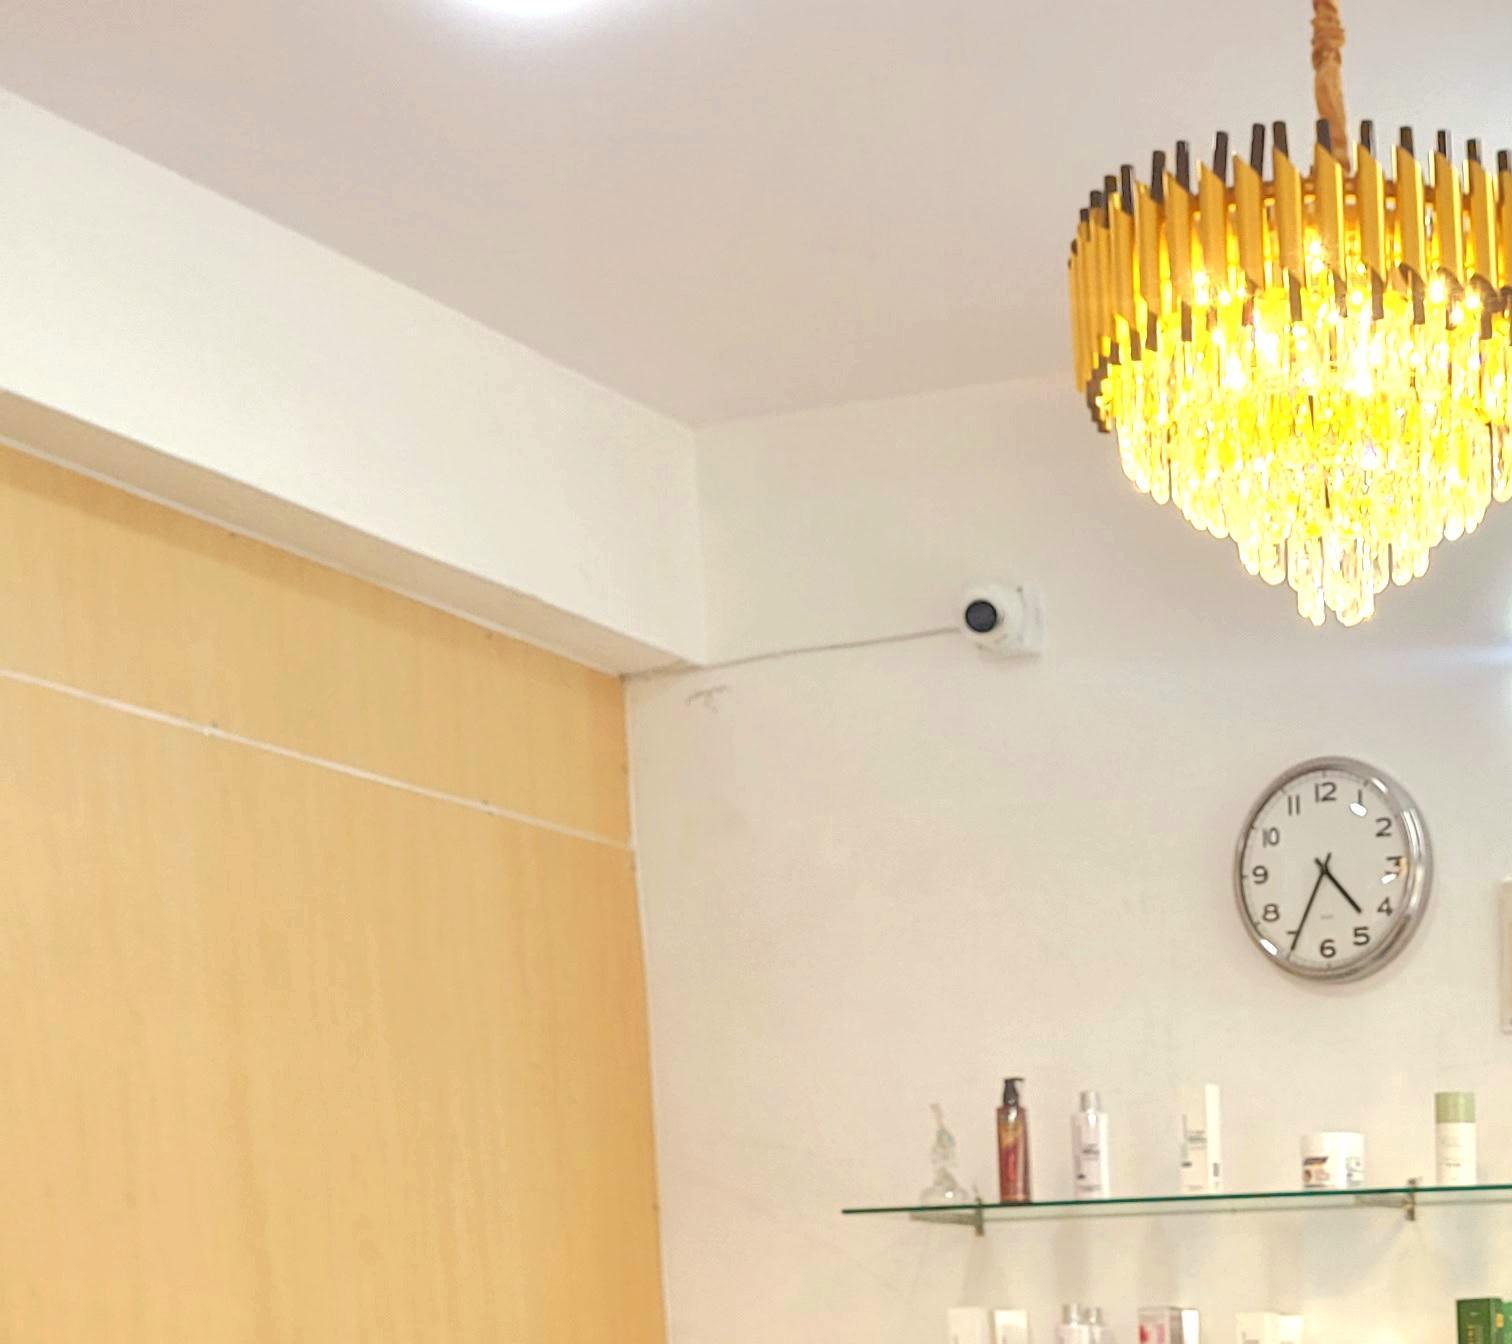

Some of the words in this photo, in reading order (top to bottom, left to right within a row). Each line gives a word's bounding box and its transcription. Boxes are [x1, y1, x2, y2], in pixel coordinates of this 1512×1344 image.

[1314, 781, 1337, 803] 12
[1287, 795, 1300, 816] 11
[1262, 826, 1280, 848] 10
[1375, 817, 1392, 837] 2
[1252, 865, 1269, 885] 9
[1262, 903, 1280, 922] 8
[1377, 897, 1393, 916] 4
[1353, 926, 1370, 946] 5
[1319, 939, 1336, 959] 6
